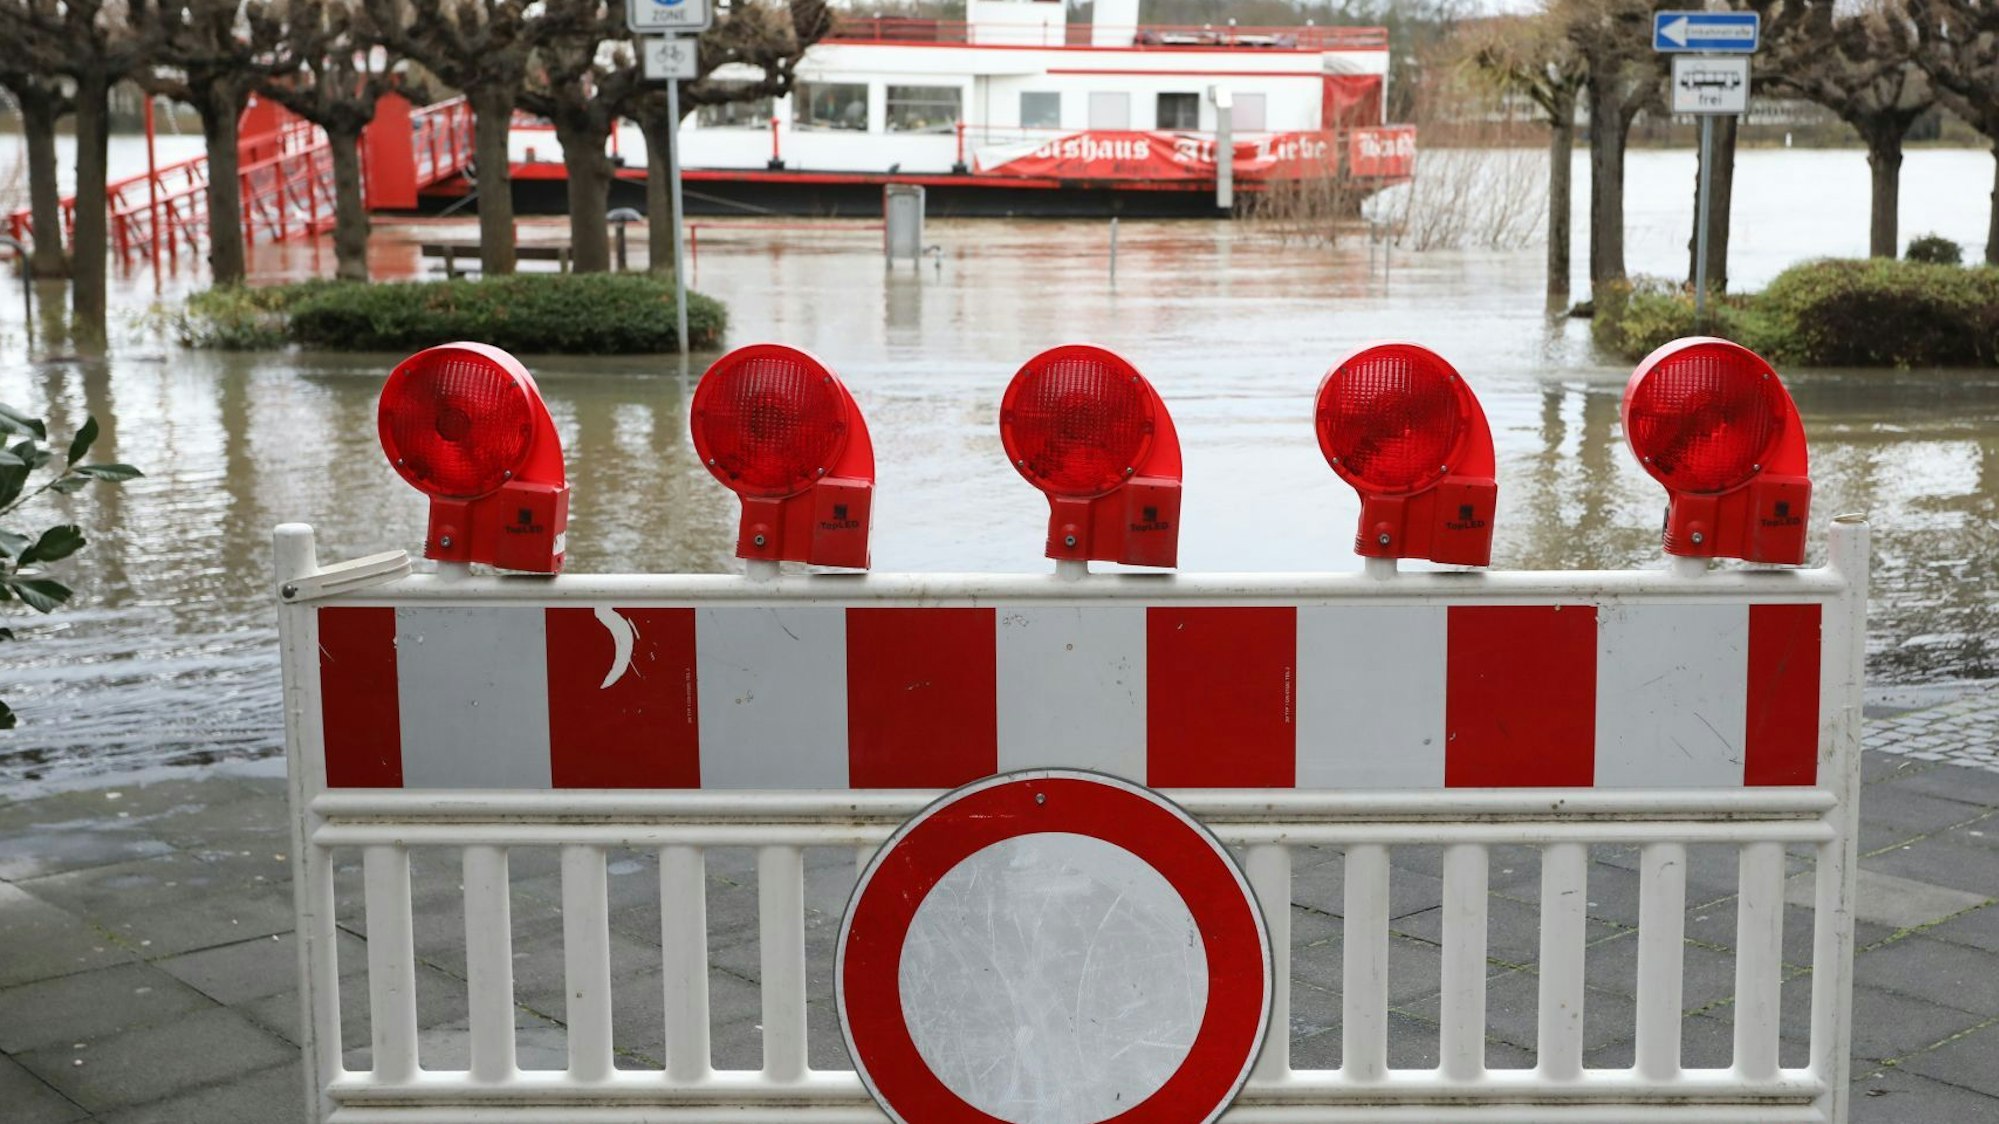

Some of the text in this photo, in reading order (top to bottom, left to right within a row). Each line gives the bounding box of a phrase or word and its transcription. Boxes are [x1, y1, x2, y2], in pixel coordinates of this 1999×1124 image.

[652, 8, 687, 21] ZONE
[1699, 94, 1722, 105] frei
[820, 520, 859, 530] TopLED
[1130, 522, 1169, 532] TopLED
[1446, 520, 1485, 530] TopLED
